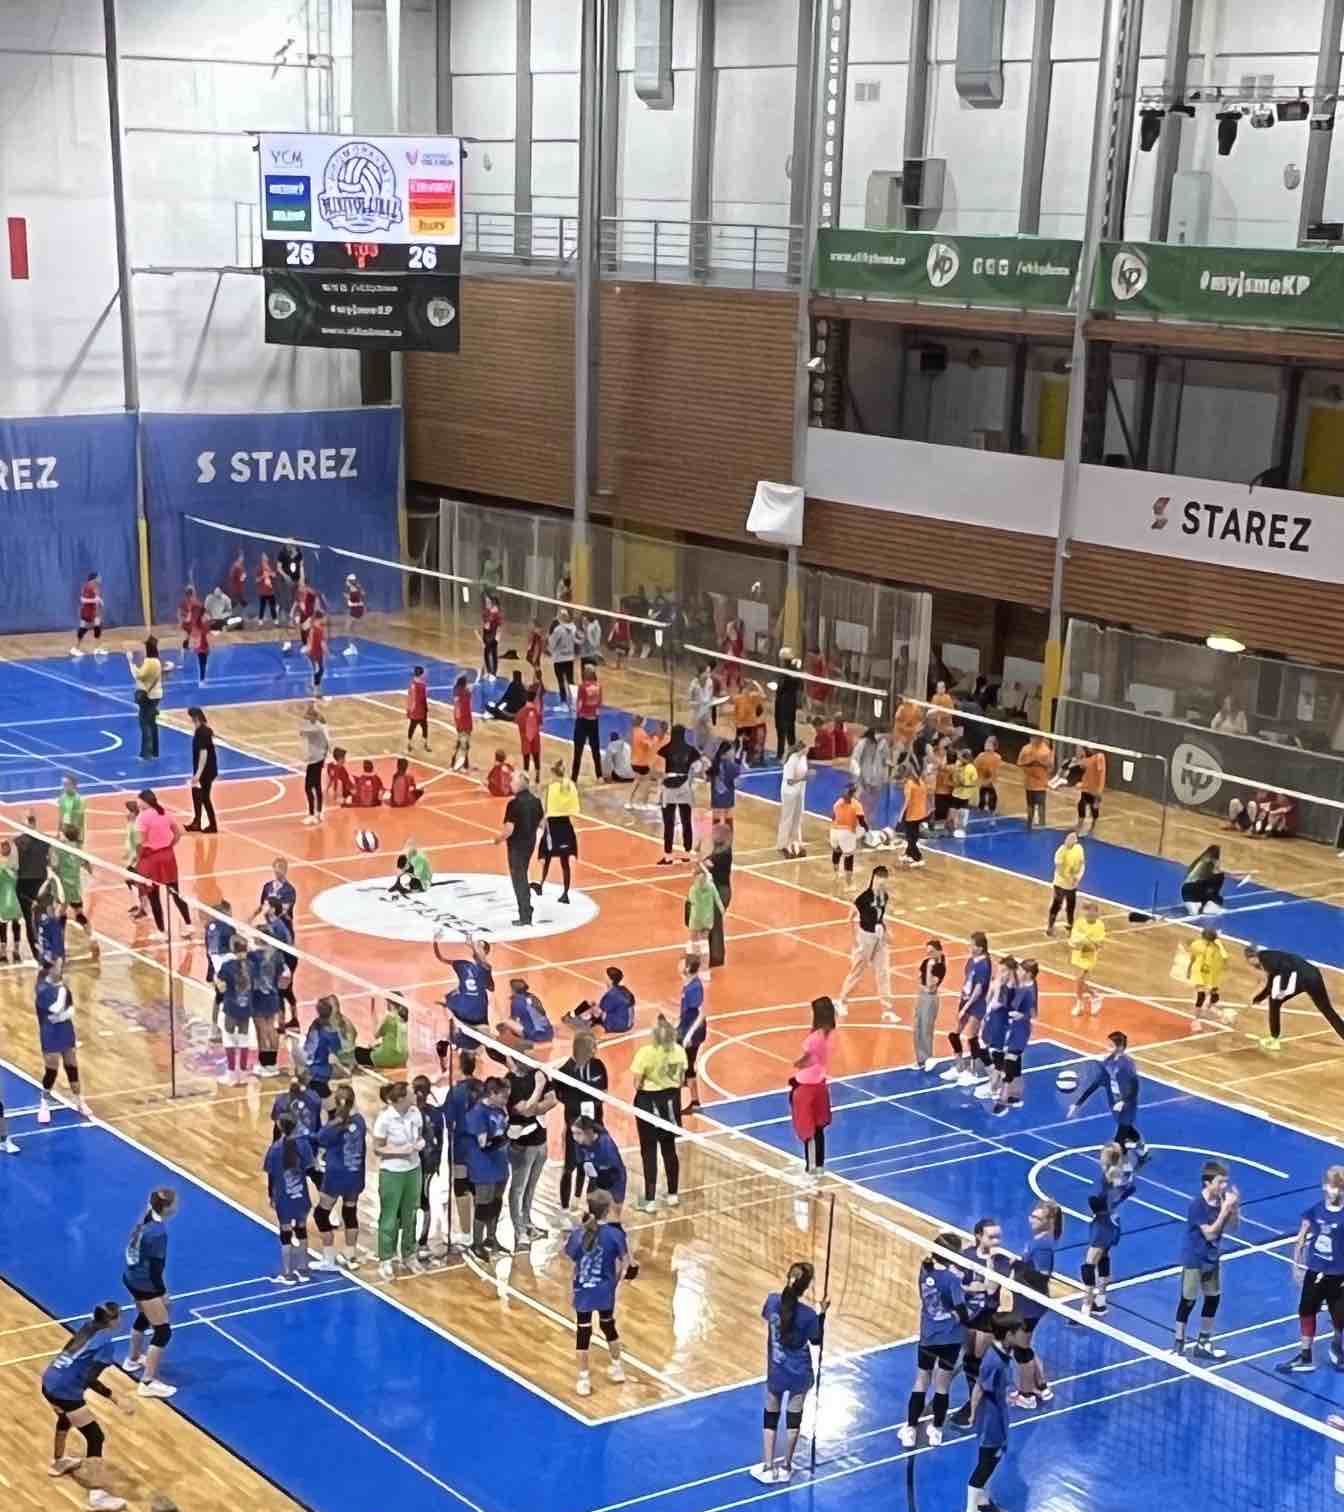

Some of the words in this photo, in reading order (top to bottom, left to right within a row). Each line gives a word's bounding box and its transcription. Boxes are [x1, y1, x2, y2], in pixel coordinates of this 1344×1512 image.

[286, 242, 315, 266] 26
[408, 246, 437, 270] 26
[230, 446, 358, 483] STAREZ
[1181, 500, 1313, 553] STAREZ
